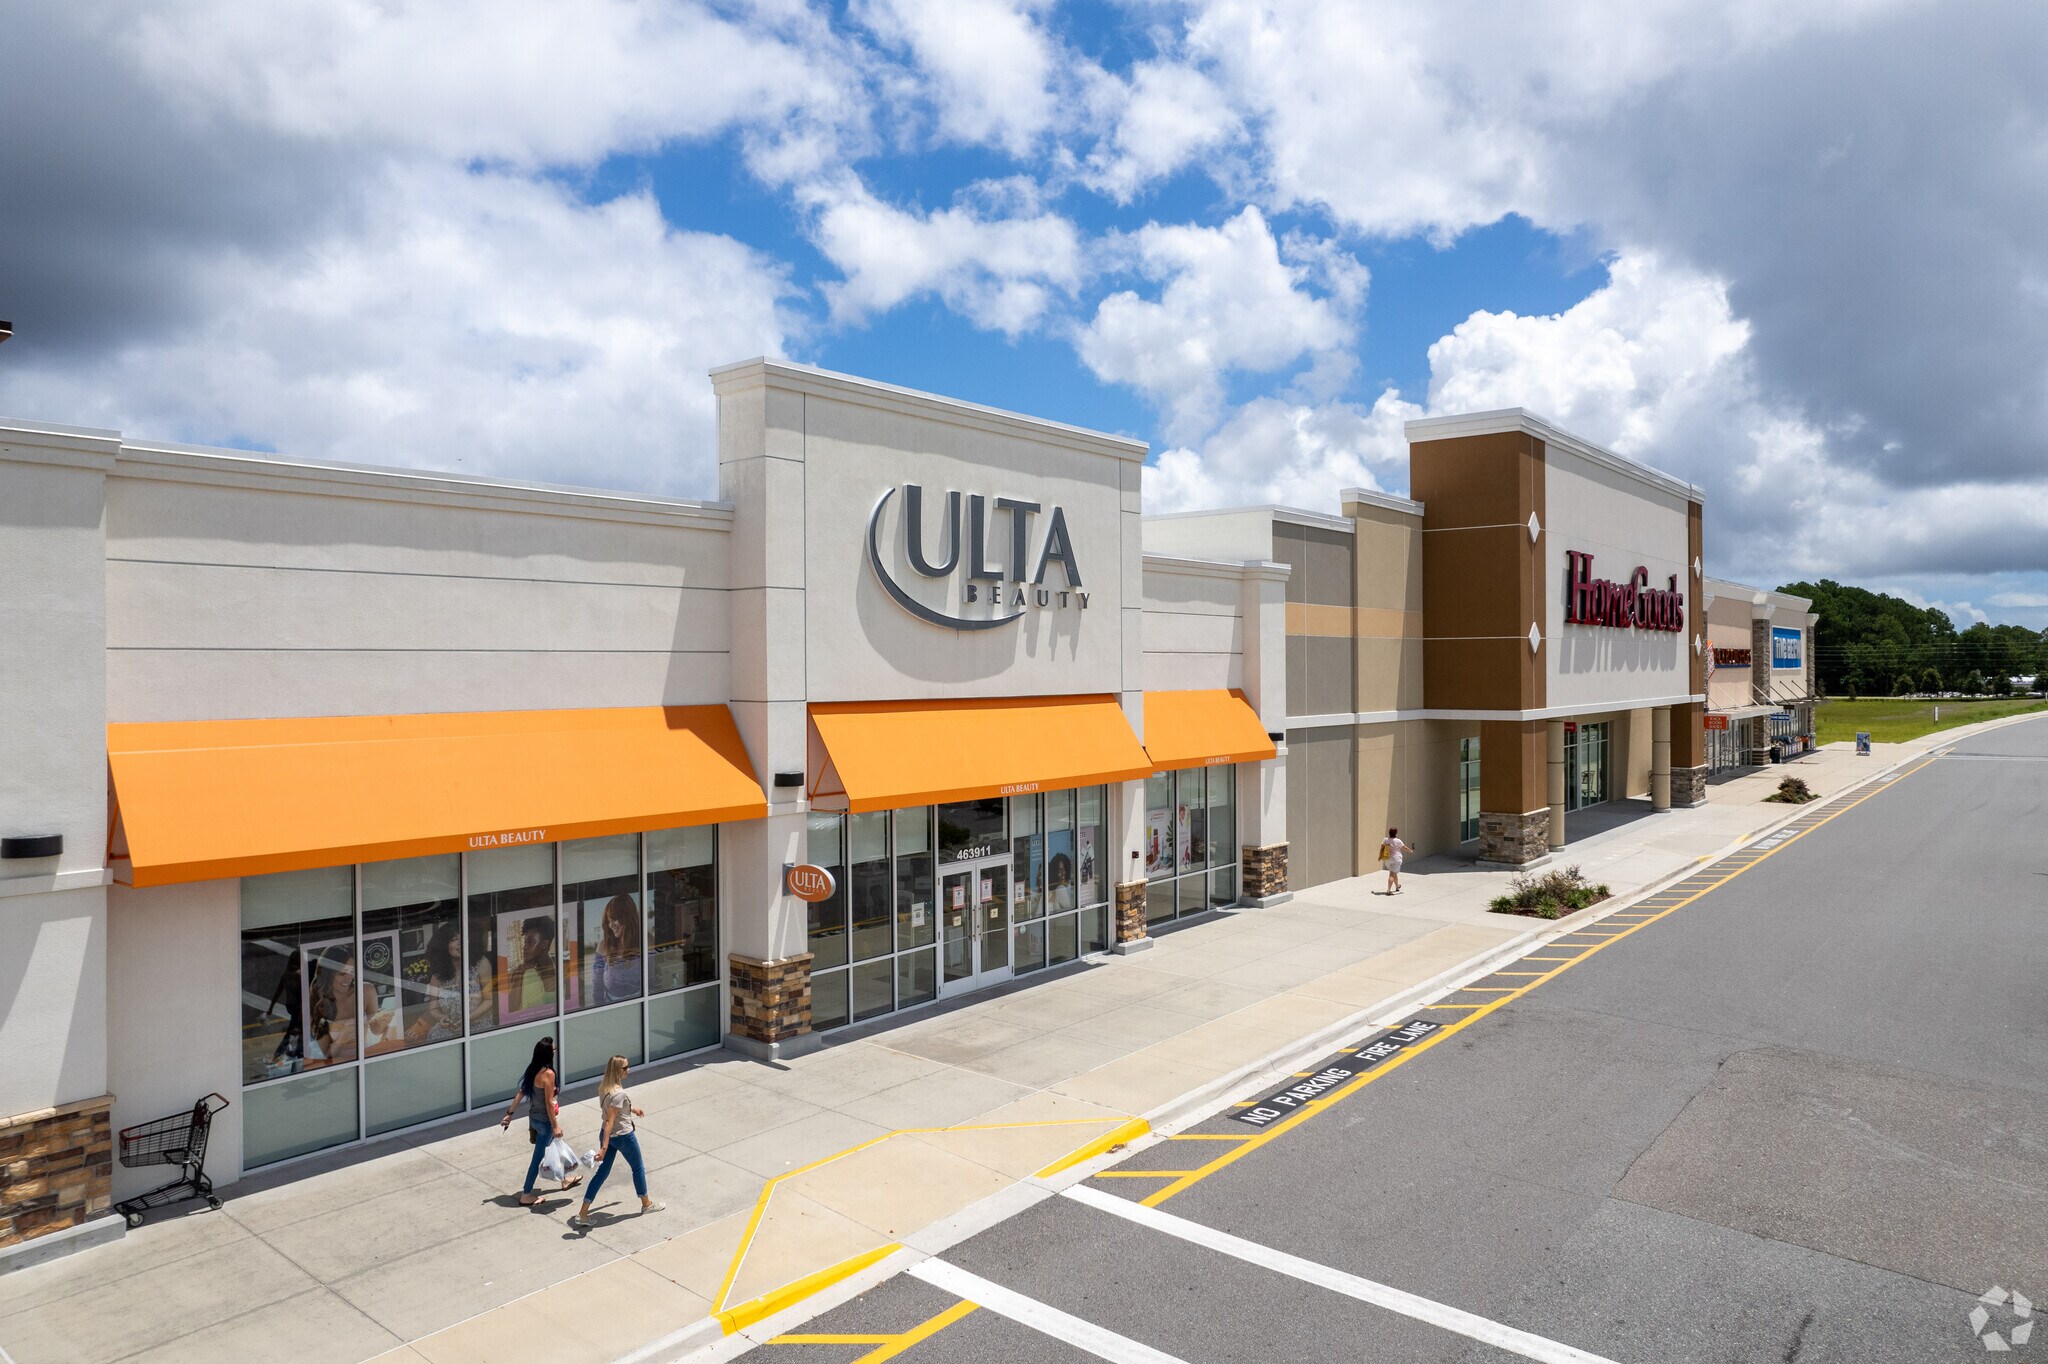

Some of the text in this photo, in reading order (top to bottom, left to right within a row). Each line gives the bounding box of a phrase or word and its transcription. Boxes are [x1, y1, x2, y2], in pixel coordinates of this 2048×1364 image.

[902, 484, 1082, 587] ULTA
[964, 584, 1090, 609] BEAUTY
[1565, 550, 1684, 632] HomeGoods
[1000, 782, 1039, 794] ULTA BEAUTY
[469, 829, 546, 848] ULTA BEAUTY
[957, 845, 991, 860] 463911
[795, 870, 826, 891] ULTA
[1240, 1021, 1437, 1124] NO PARKING FIRE LANE
